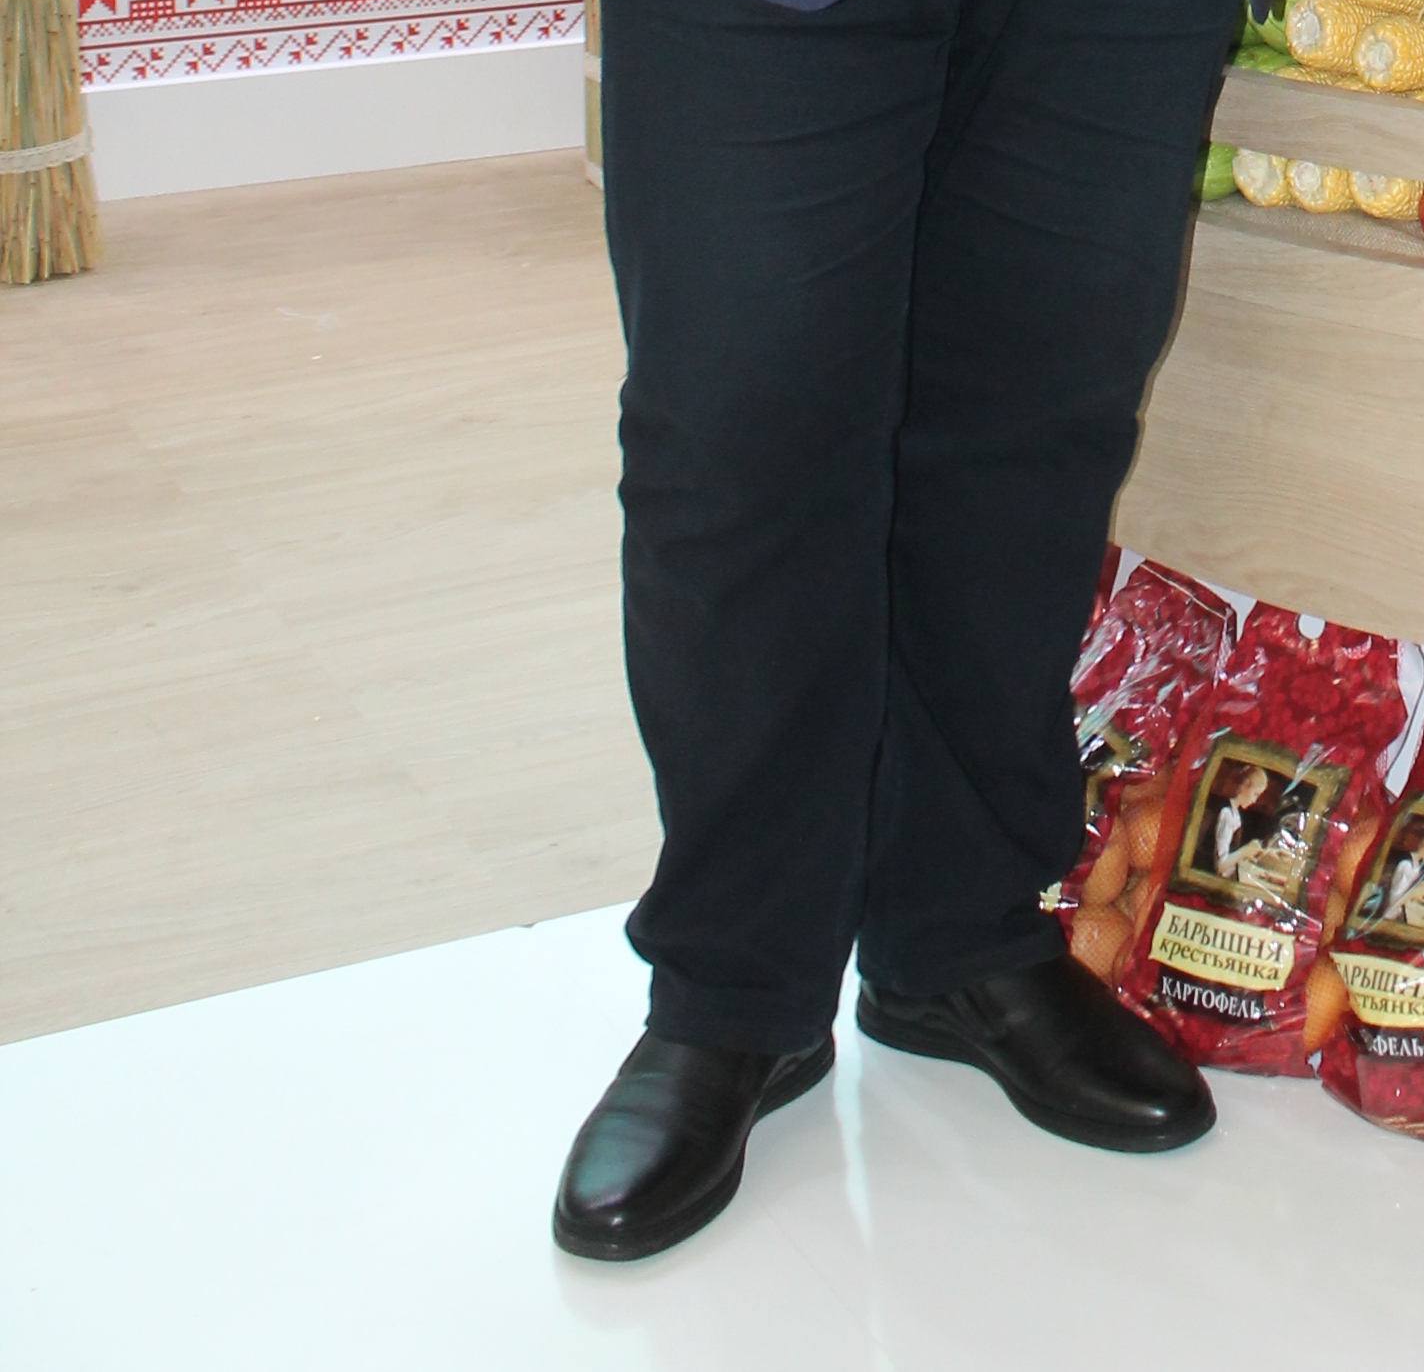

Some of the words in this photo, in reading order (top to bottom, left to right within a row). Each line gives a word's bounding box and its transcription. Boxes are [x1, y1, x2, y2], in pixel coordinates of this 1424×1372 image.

[1159, 938, 1280, 981] крестьянка
[1166, 914, 1284, 963] БАРЫШНЯ
[1161, 976, 1262, 1019] КАРТОФЕЛЬ
